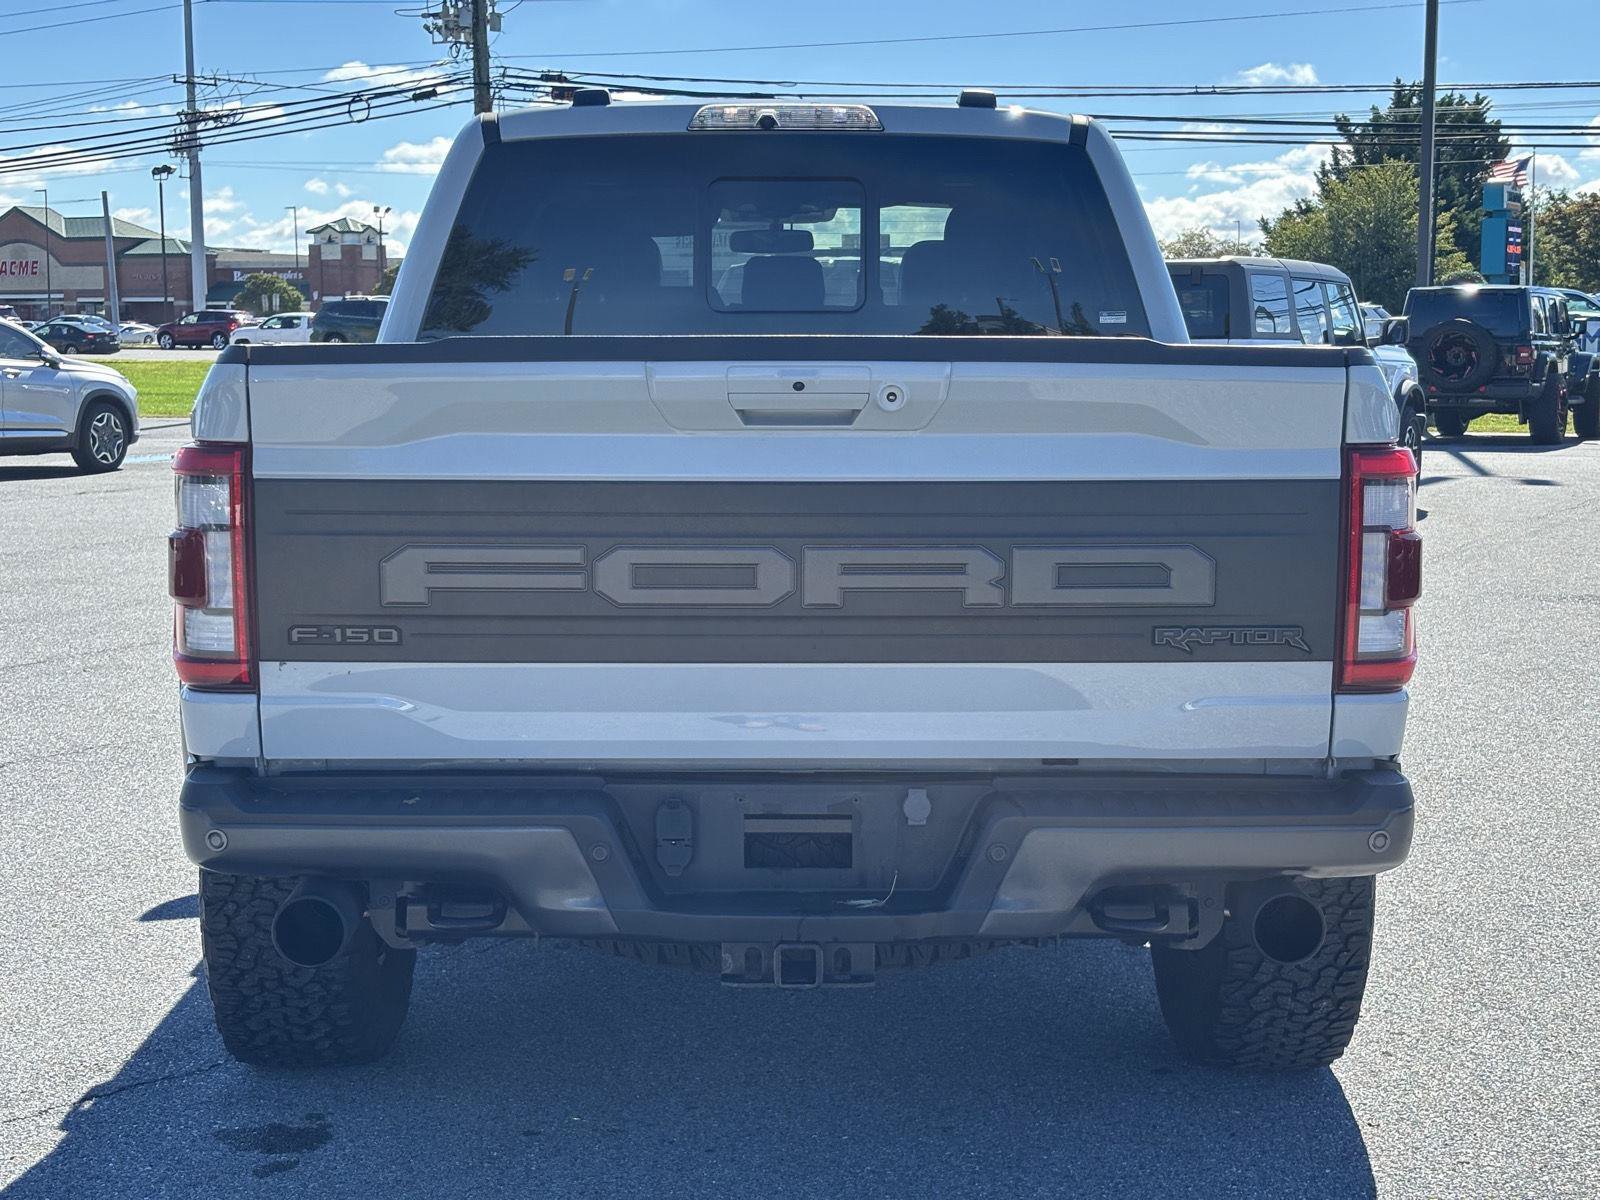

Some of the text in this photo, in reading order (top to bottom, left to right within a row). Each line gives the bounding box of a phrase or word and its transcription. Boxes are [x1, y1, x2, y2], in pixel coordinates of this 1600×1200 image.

[0, 260, 39, 276] ACME
[379, 543, 1216, 607] FORD
[289, 626, 401, 644] F-150
[1153, 626, 1311, 652] RAPTOR
